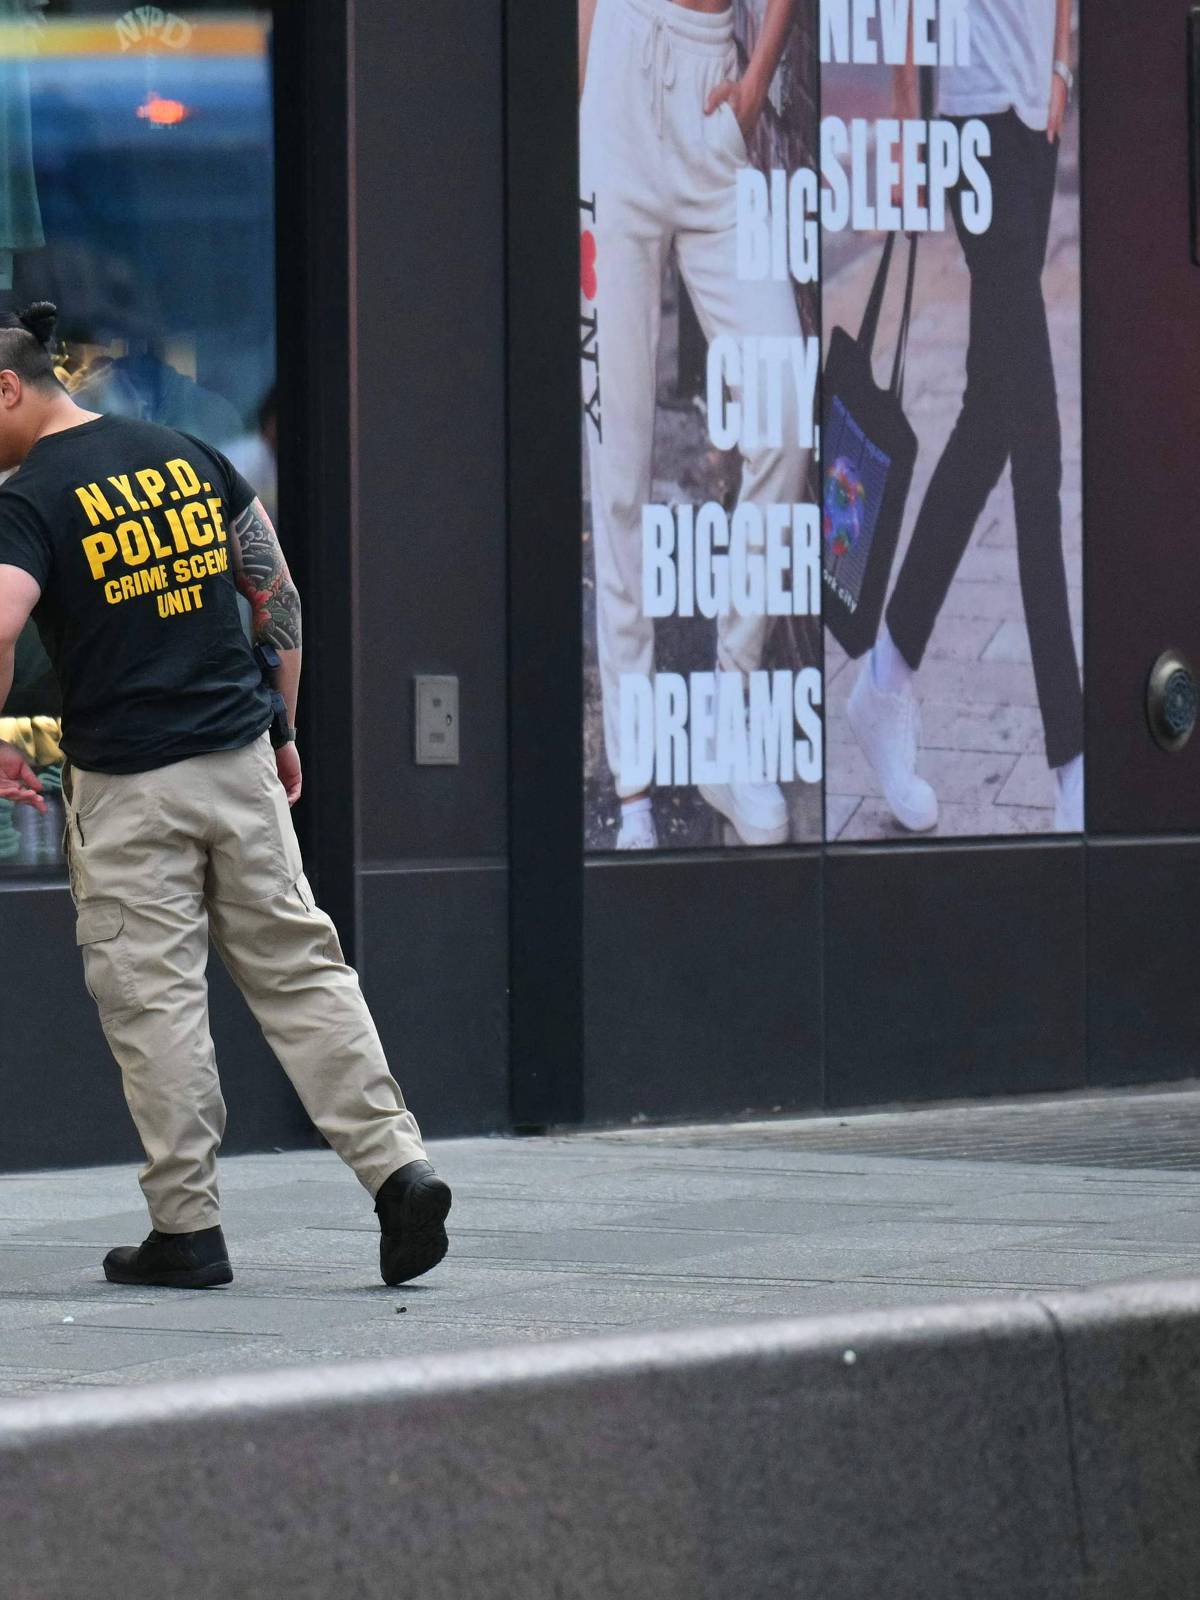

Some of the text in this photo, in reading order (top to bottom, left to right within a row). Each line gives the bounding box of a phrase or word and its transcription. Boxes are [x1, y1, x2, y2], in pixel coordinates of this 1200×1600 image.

[114, 5, 193, 52] NYPD
[821, 0, 970, 65] NEVER
[820, 114, 993, 236] SLEEPS
[736, 167, 819, 285] BIG
[578, 304, 603, 445] NY
[74, 457, 212, 527] N.Y.P.D.
[81, 497, 228, 581] POLICE
[104, 547, 228, 605] CRIME SCENE
[642, 503, 821, 618] BIGGER
[156, 584, 203, 619] UNIT
[619, 668, 822, 786] DREAMS
